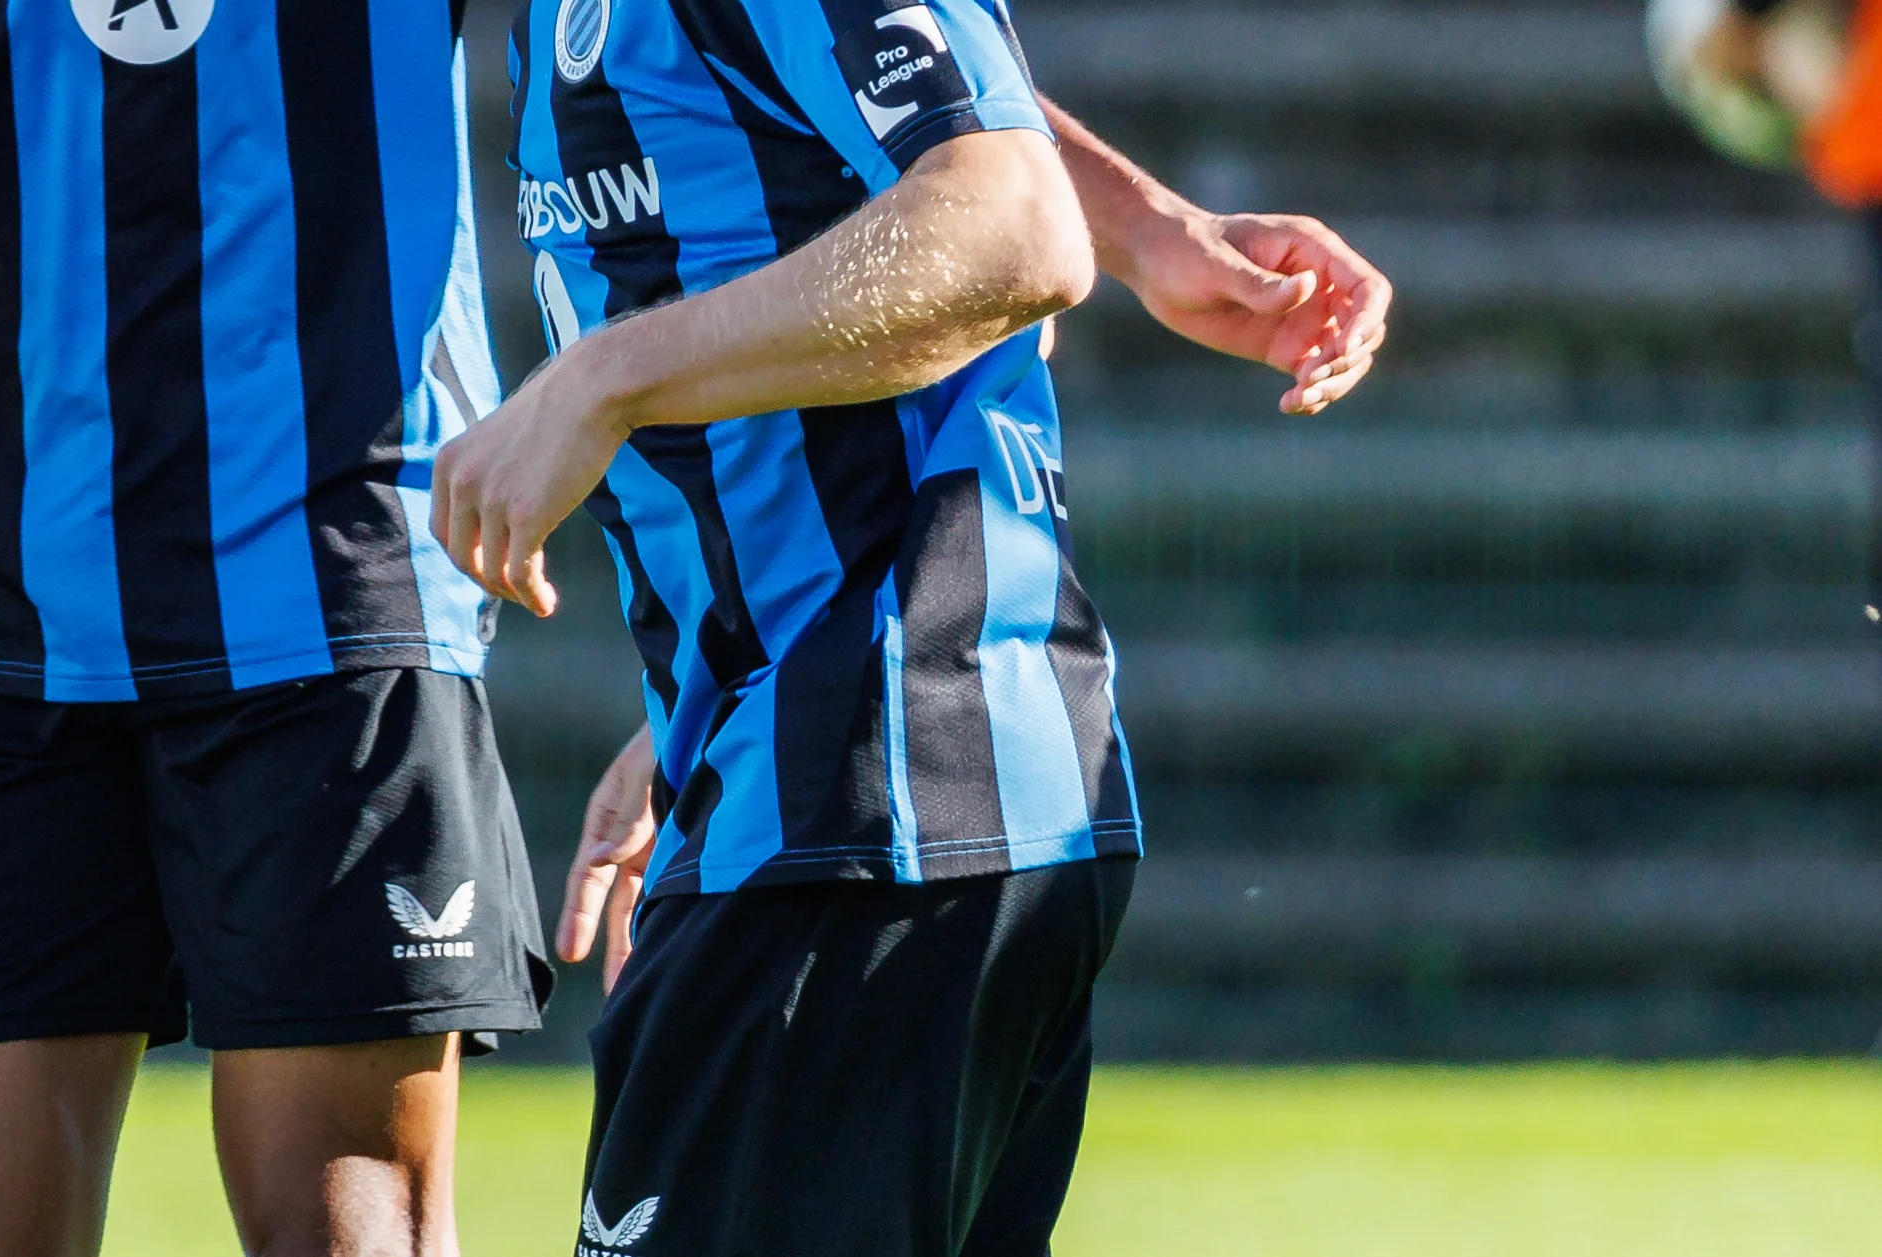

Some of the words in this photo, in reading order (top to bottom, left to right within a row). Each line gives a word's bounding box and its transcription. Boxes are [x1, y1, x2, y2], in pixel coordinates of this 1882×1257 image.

[875, 45, 908, 69] Pro
[868, 55, 934, 96] League
[392, 941, 474, 958] CASTORE
